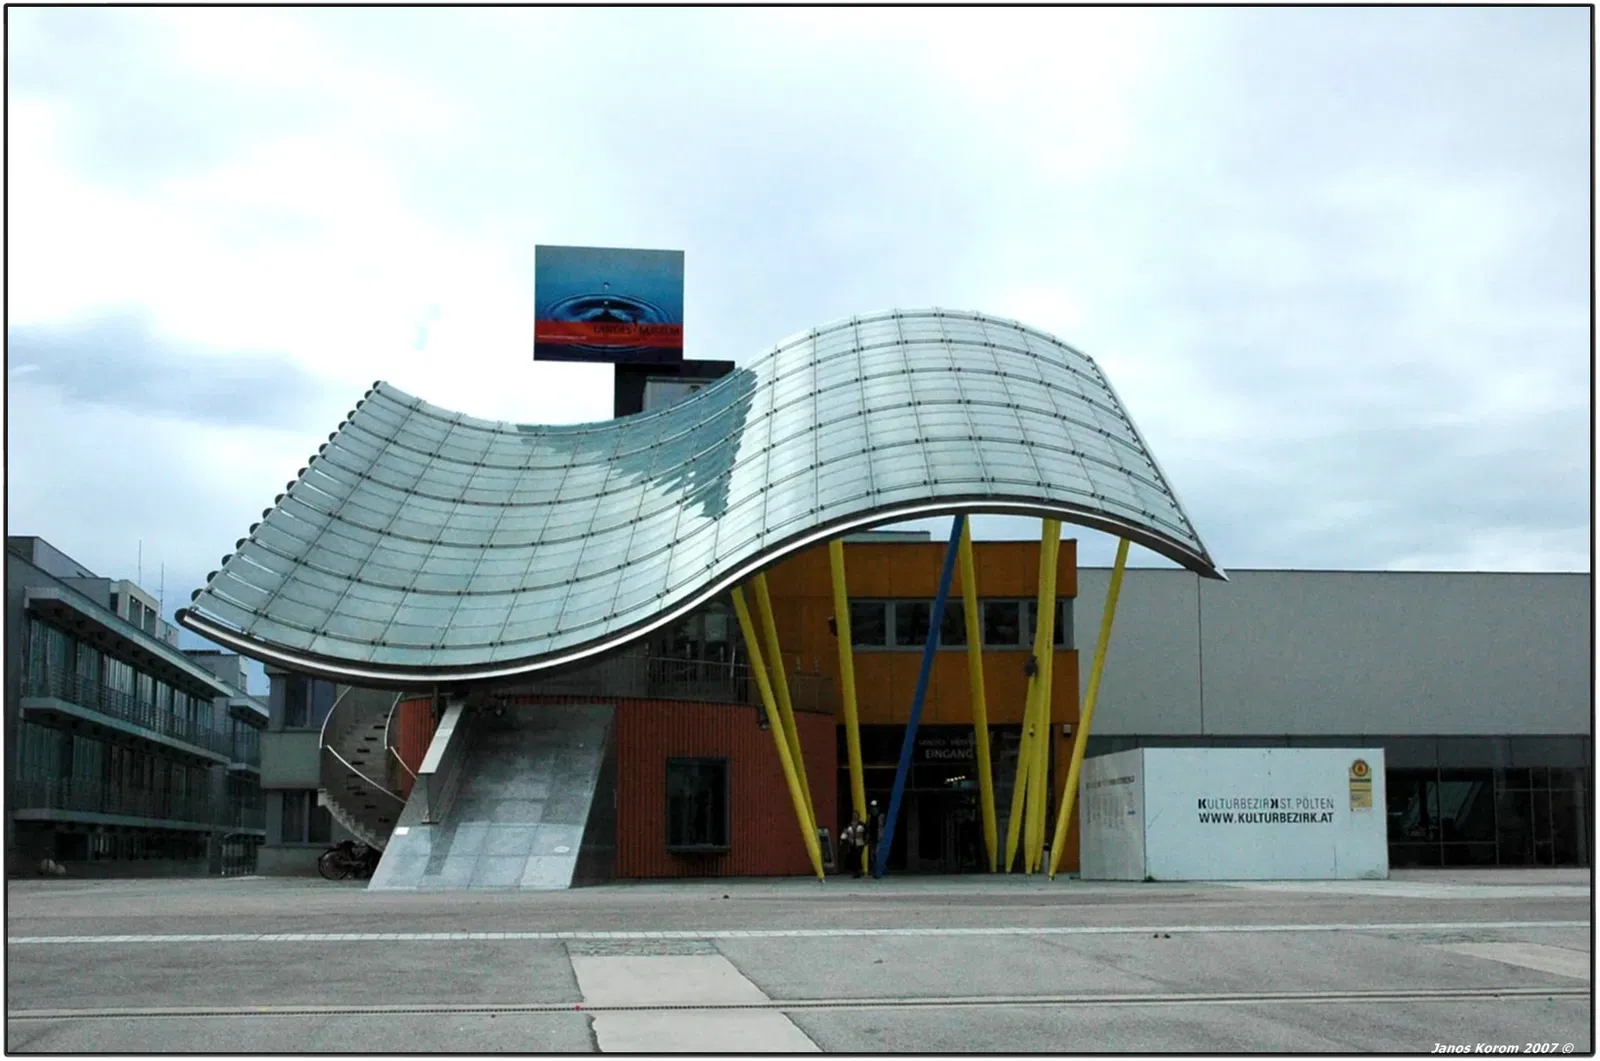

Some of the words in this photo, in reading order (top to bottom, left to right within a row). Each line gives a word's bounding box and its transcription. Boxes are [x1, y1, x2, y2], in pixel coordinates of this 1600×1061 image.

[925, 748, 974, 759] EINGANG
[1296, 796, 1334, 810] PÖLTEN
[1199, 811, 1335, 824] WWW.KULTURBEZIRK.AT
